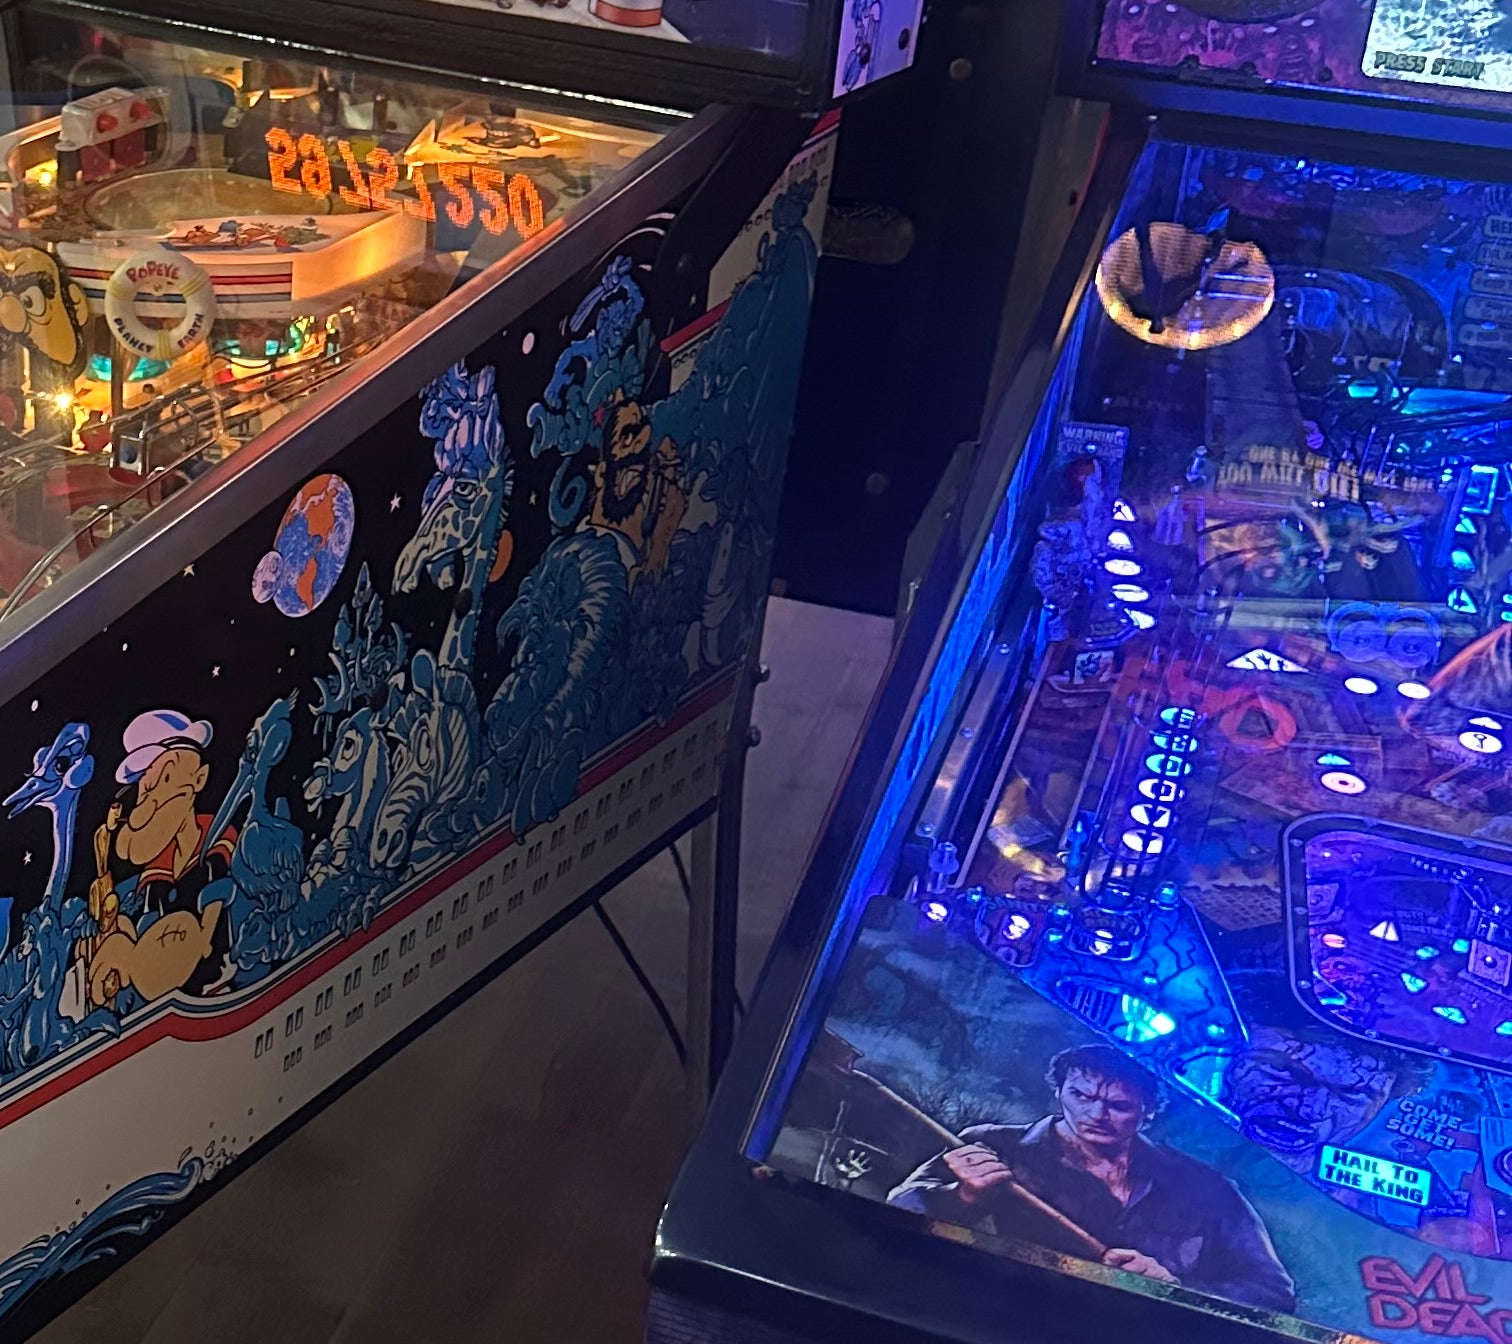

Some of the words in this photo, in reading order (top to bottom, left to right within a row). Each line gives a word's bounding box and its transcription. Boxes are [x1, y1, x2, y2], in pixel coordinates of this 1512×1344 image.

[1374, 50, 1428, 74] PRESS
[1430, 57, 1485, 81] START
[125, 260, 180, 285] POPEYE
[112, 316, 156, 355] PLANET
[177, 313, 205, 350] EARTH
[1061, 425, 1125, 444] WARNING
[1398, 1098, 1464, 1130] COME
[1385, 1117, 1456, 1150] SOME!
[1332, 1148, 1380, 1175] HAIL
[1391, 1163, 1420, 1184] TO
[1324, 1163, 1362, 1188] THE
[1371, 1176, 1425, 1204] KING
[1359, 1252, 1492, 1306] EVIL
